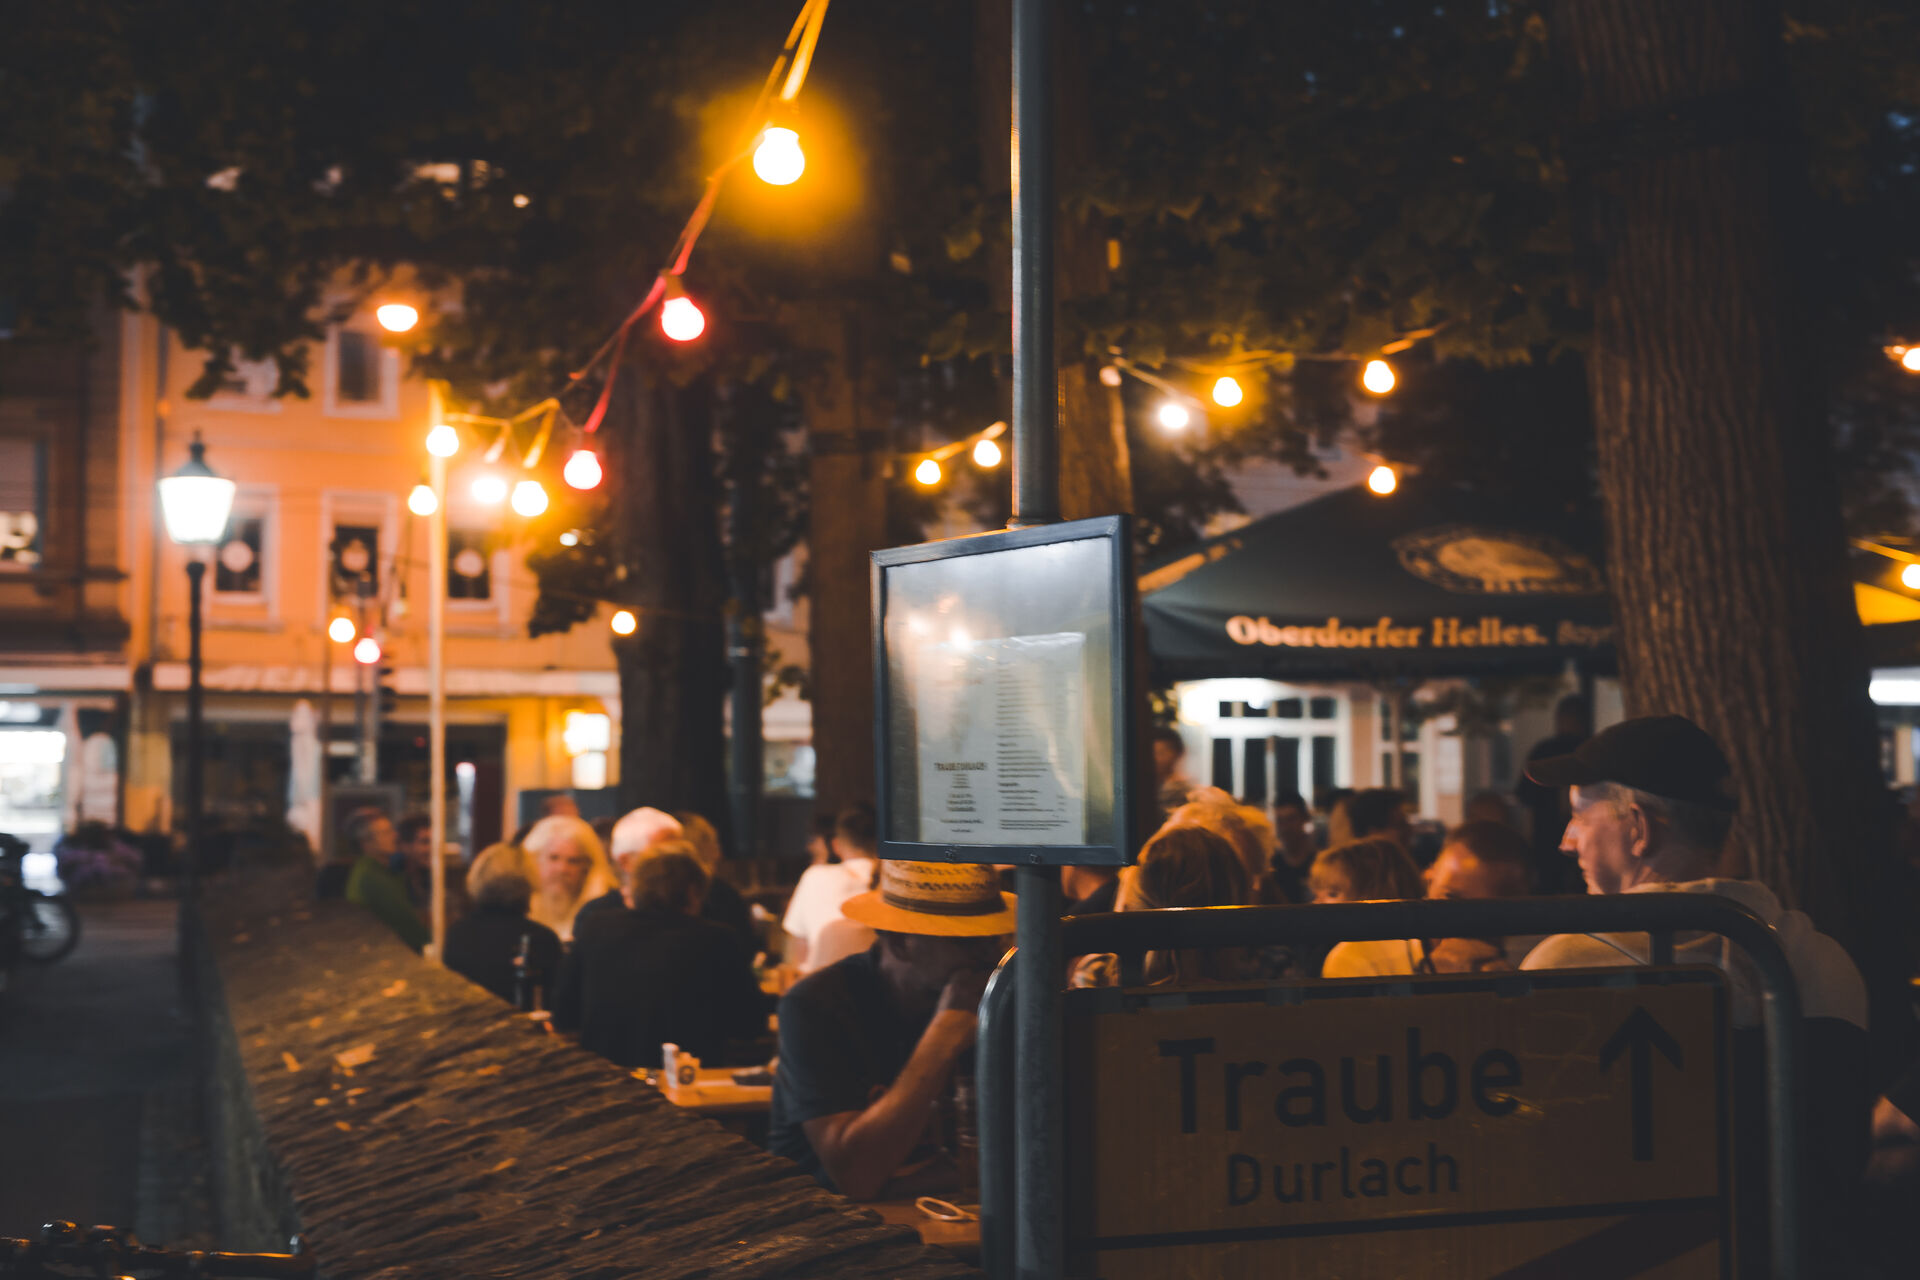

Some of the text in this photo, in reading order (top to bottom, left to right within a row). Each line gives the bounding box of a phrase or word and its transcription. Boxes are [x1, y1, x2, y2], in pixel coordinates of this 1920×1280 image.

[1226, 614, 1422, 648] Oberdorfer
[1431, 616, 1548, 647] Helles.
[1158, 1027, 1523, 1134] Traube
[1227, 1143, 1459, 1206] Durlach
